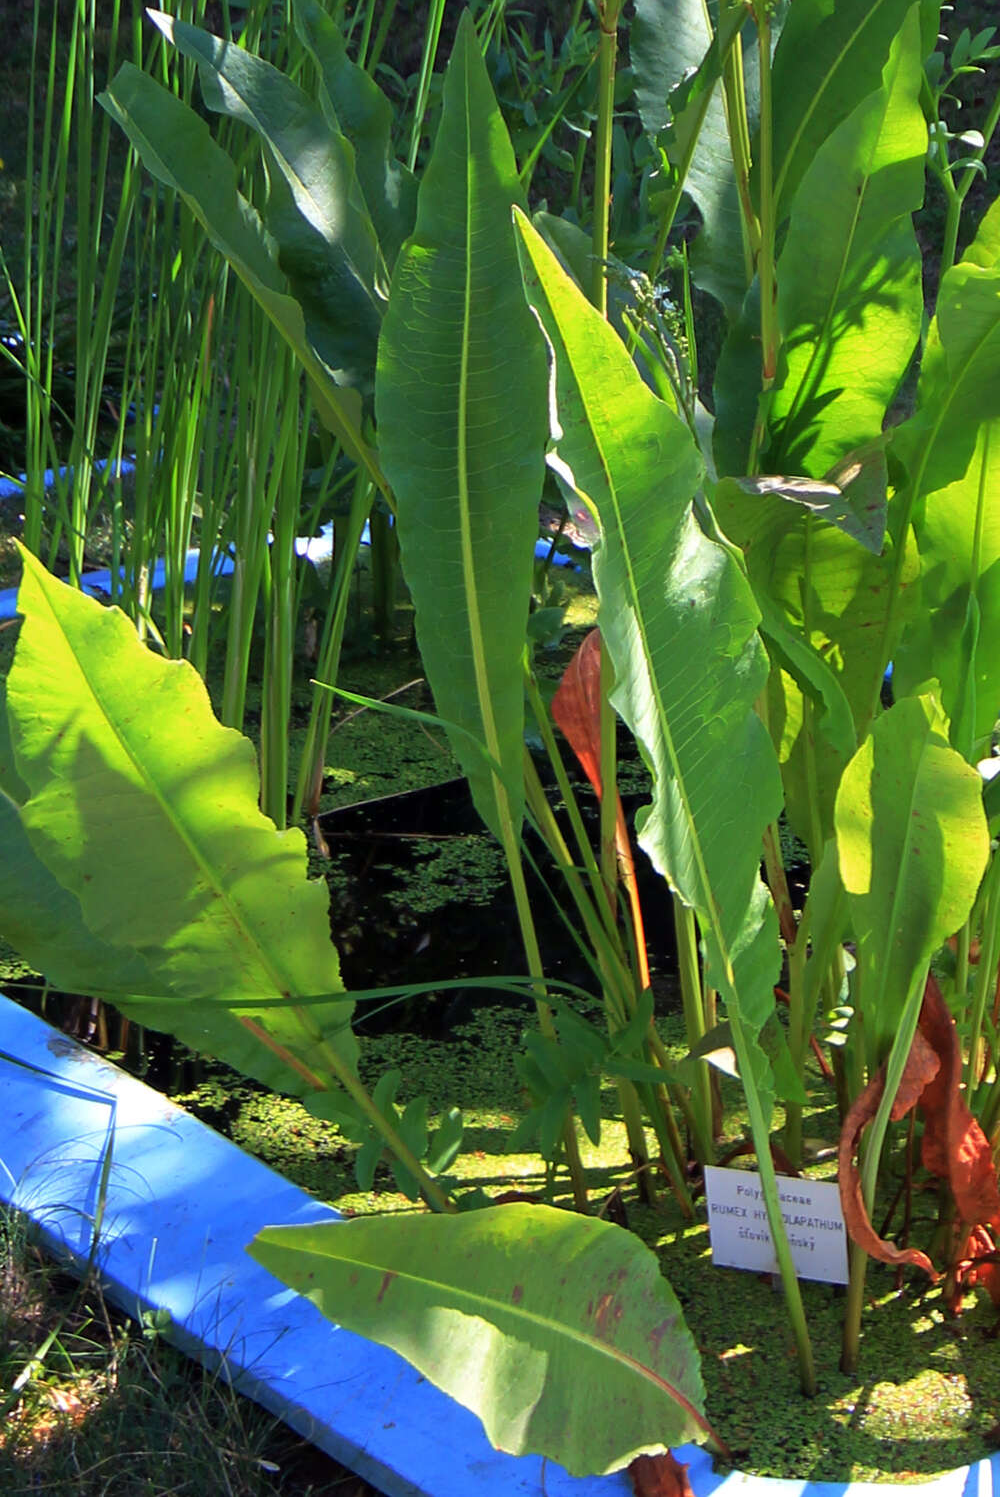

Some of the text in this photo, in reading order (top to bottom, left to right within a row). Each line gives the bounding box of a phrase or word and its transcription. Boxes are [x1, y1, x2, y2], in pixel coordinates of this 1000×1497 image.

[736, 1184, 812, 1205] Polyaceae
[711, 1203, 843, 1231] RUMEX HYOLAPATHUM
[783, 1233, 815, 1252] ňský
